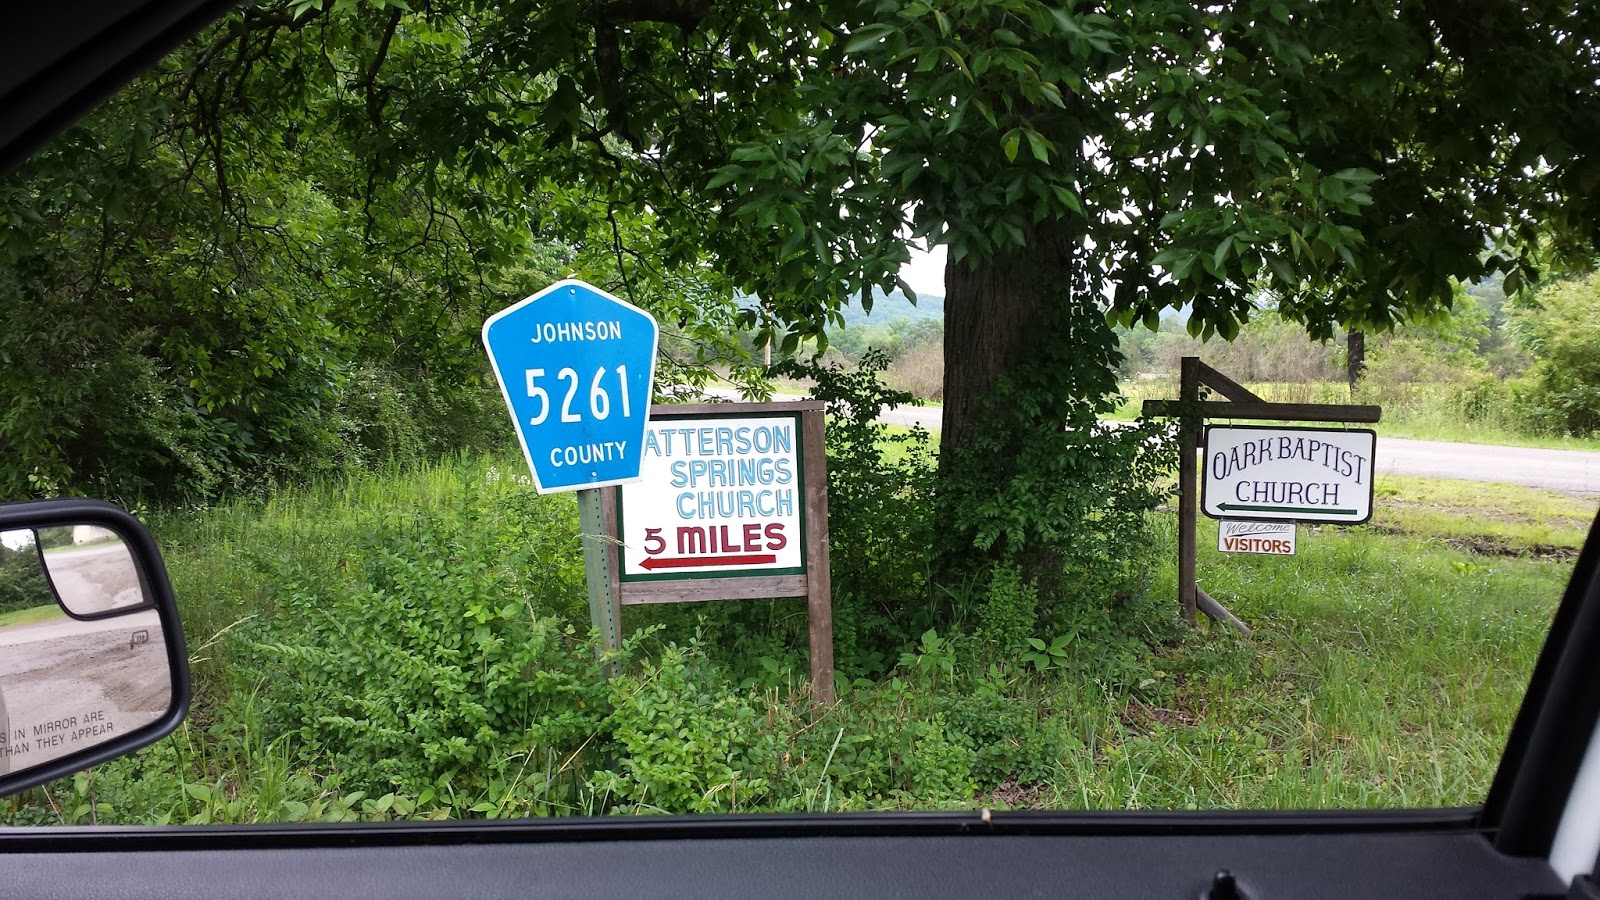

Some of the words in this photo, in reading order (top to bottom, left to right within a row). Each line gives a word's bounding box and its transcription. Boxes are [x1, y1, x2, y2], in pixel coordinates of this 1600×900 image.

[530, 321, 622, 344] JOHNSON
[524, 364, 631, 426] 5261
[550, 441, 627, 468] COUNTY
[645, 425, 791, 457] ATTERSON
[670, 458, 793, 488] SPRINGS
[1213, 437, 1274, 481] OARK
[1277, 436, 1367, 485] BAPTIST
[676, 489, 793, 519] CHURCH
[1235, 480, 1341, 506] CHURCH
[644, 528, 667, 556] 5
[676, 523, 787, 554] MILES
[1226, 522, 1290, 535] Welcome
[1223, 537, 1291, 553] VISITORS
[0, 742, 30, 758] THAN
[36, 734, 65, 750] THEY
[71, 722, 114, 741] APPEAR
[14, 728, 26, 740] IN
[33, 716, 77, 736] MIRROR
[83, 710, 105, 723] ARE
